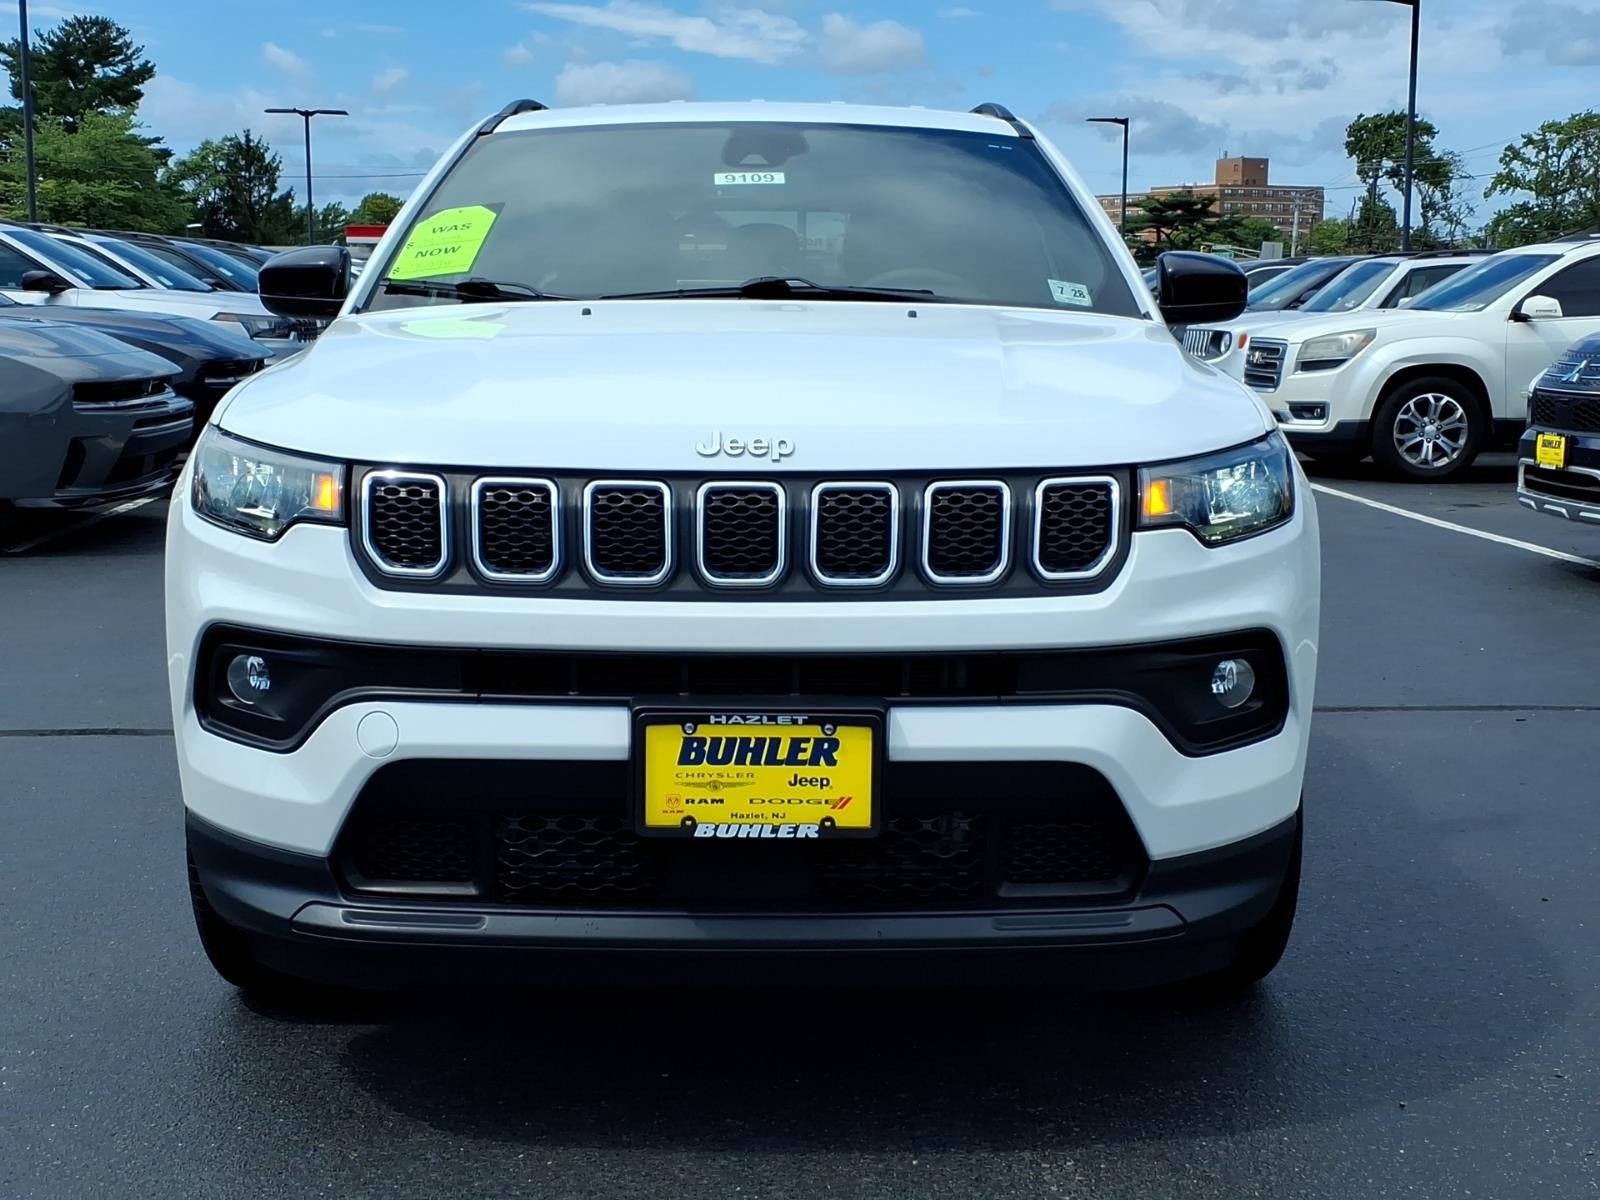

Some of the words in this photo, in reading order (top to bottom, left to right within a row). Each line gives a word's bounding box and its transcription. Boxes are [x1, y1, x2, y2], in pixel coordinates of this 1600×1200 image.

[724, 173, 775, 183] 9109
[432, 223, 472, 234] WAS
[415, 246, 461, 258] NOW
[1057, 286, 1064, 295] 7
[695, 430, 796, 463] Jeep
[710, 715, 808, 725] HAZLET
[677, 736, 840, 767] BUHLER
[788, 773, 830, 789] Jeep
[693, 824, 820, 838] BUHLER
